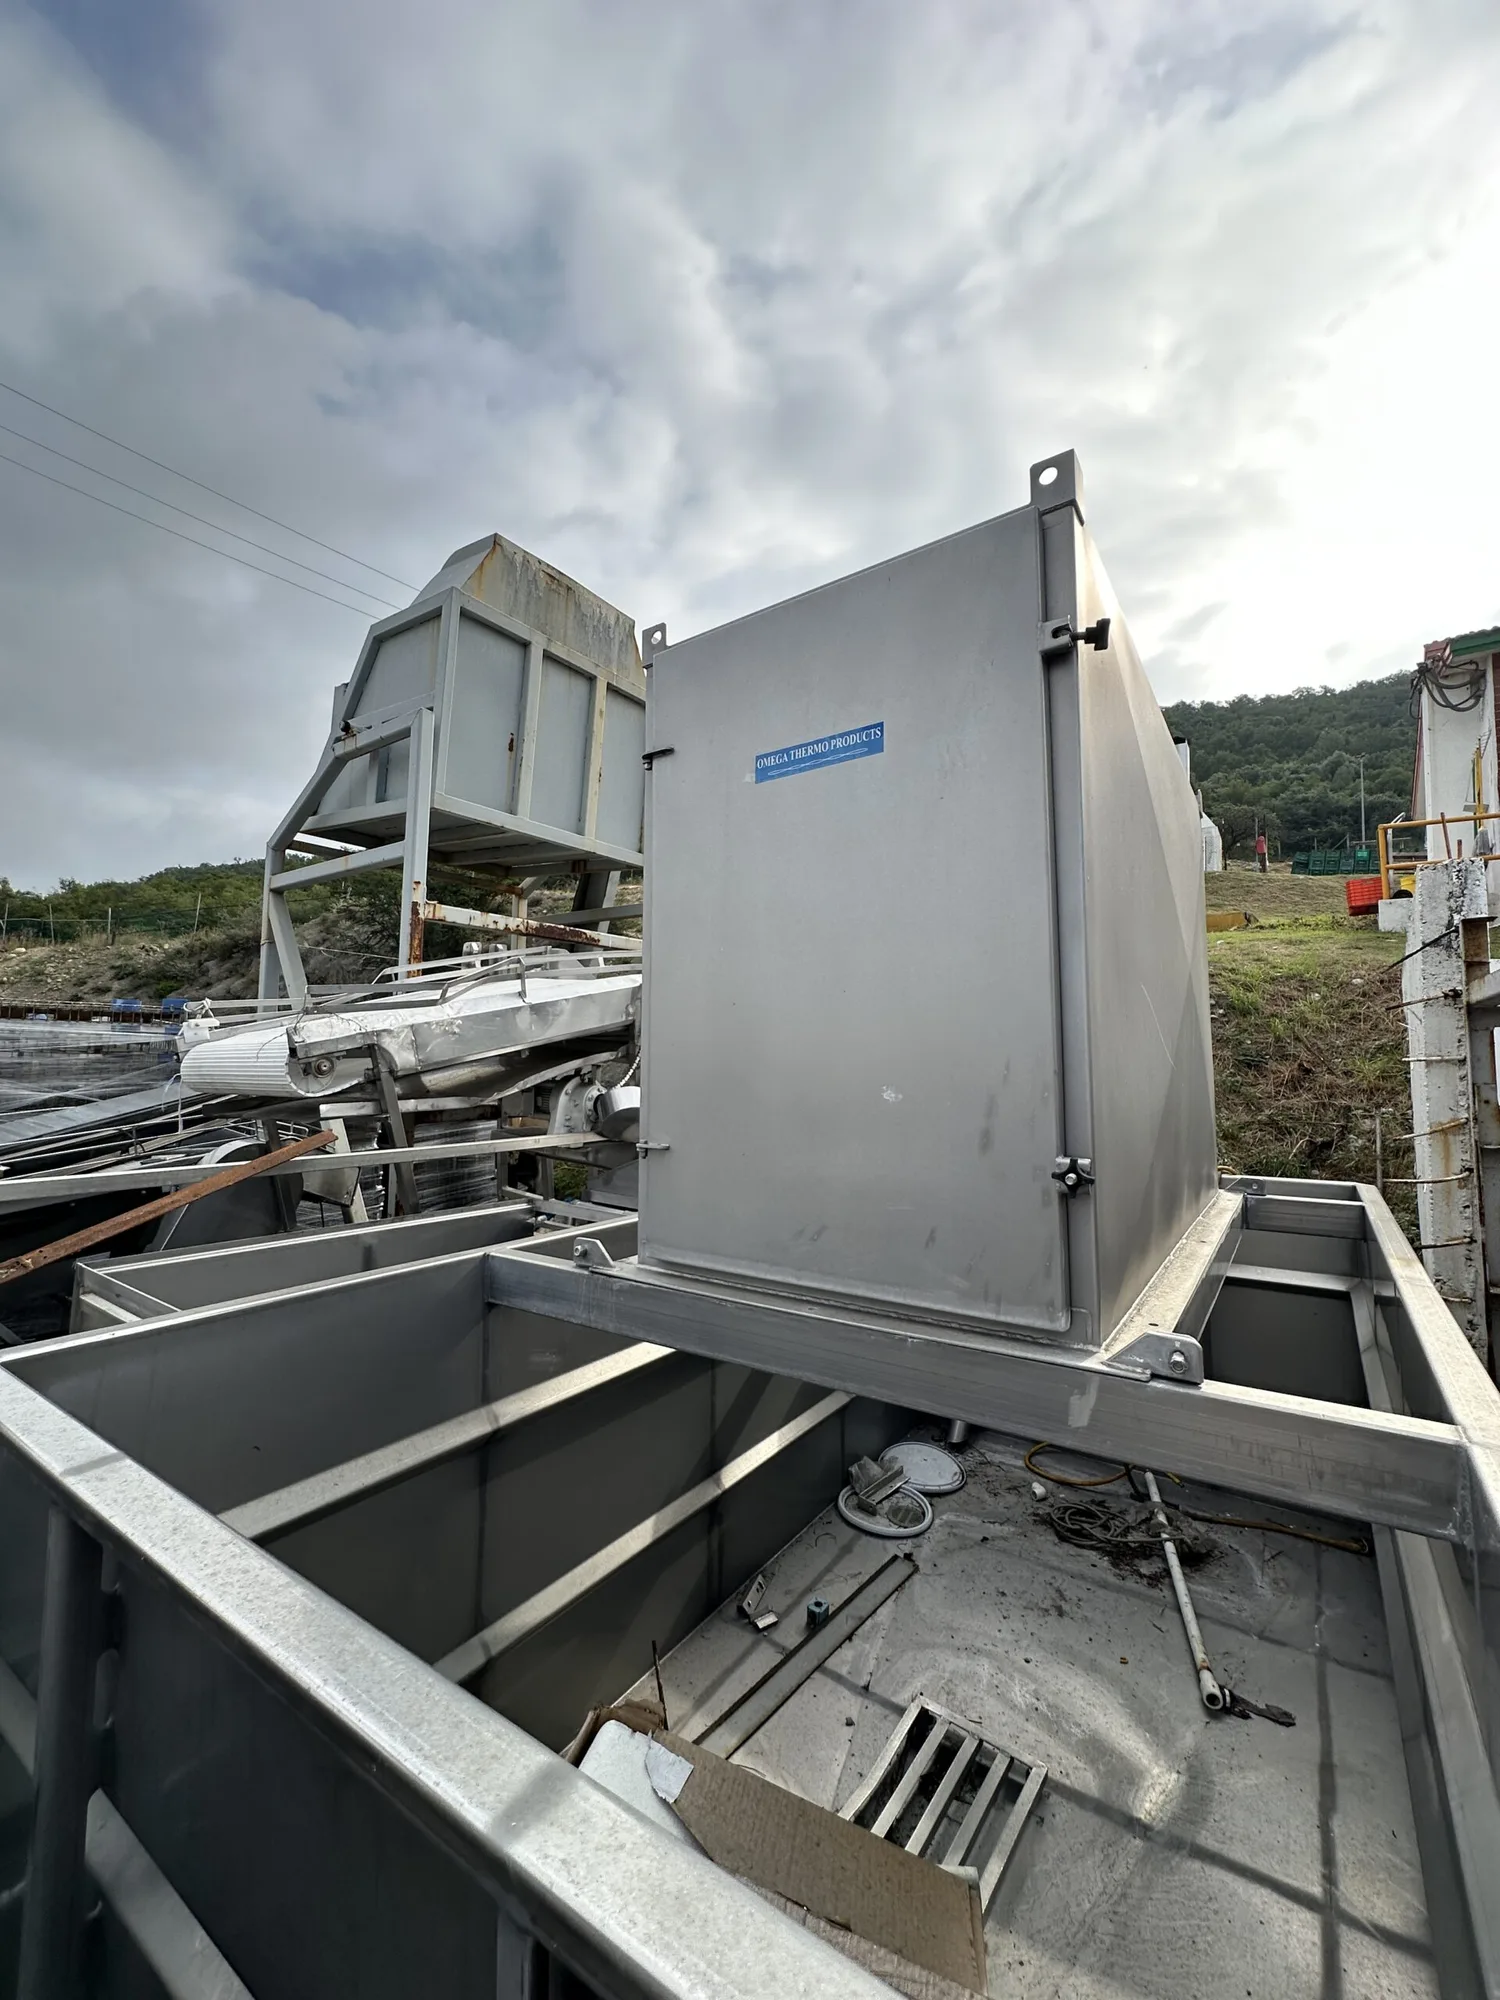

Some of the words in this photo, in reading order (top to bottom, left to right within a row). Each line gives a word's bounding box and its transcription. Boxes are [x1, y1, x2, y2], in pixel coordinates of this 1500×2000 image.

[757, 753, 788, 769] OMEGA
[790, 741, 829, 761] THERMO
[831, 727, 882, 750] PRODUCTS
